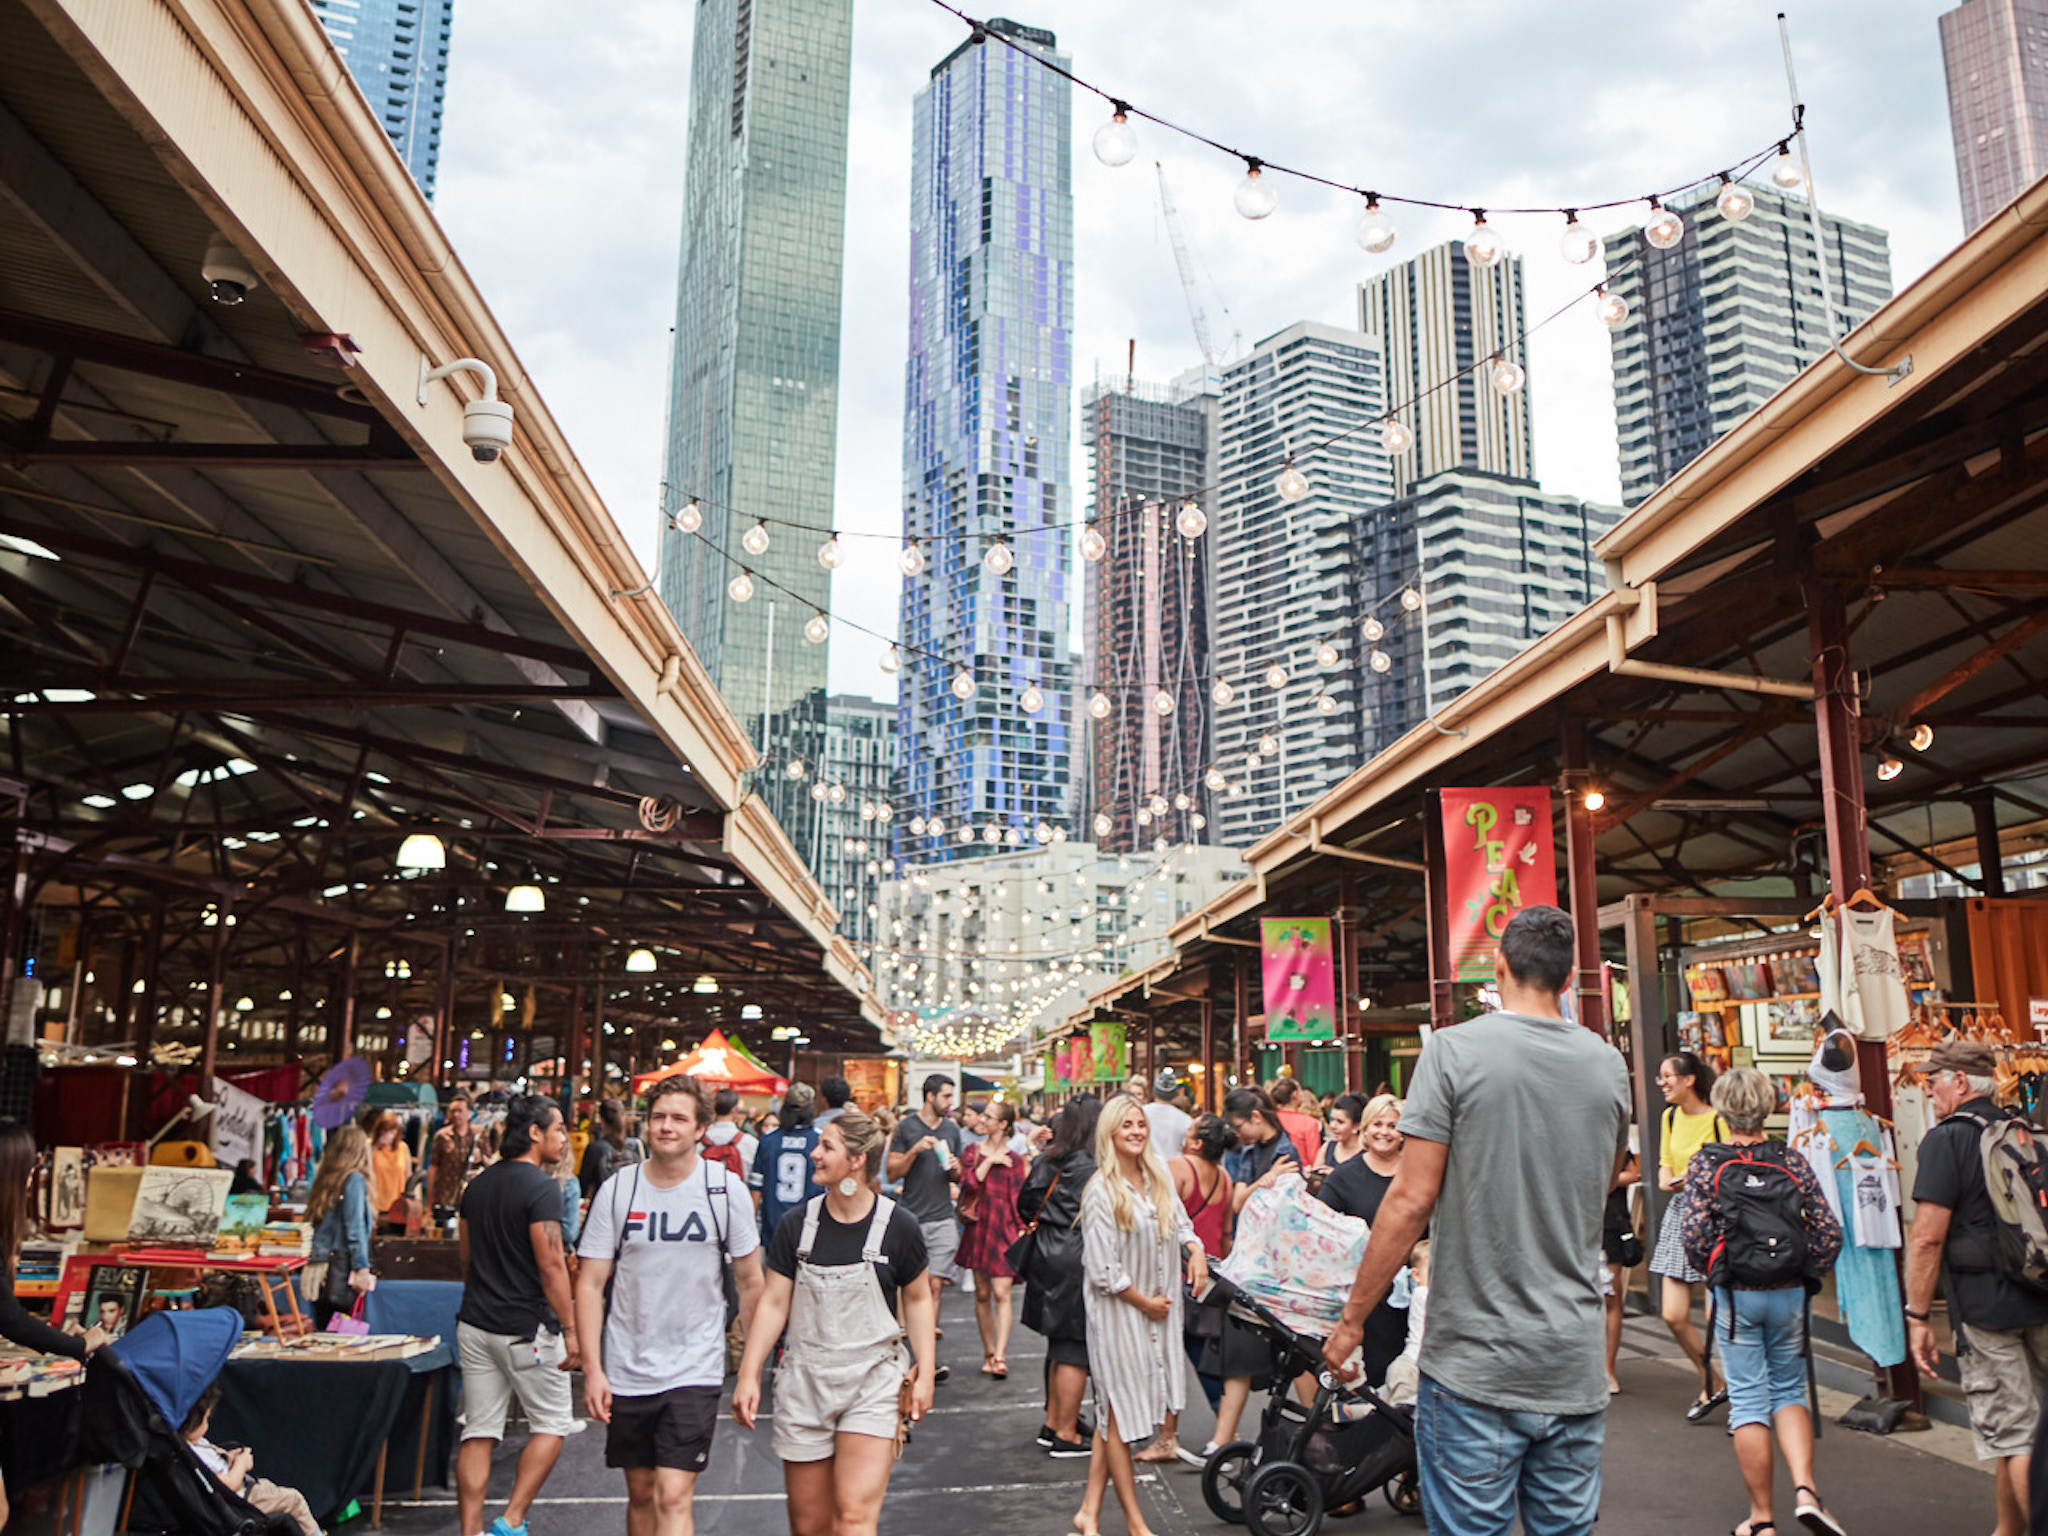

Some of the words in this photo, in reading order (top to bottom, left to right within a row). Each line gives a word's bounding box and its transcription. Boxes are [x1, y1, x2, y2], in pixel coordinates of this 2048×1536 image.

[1098, 1027, 1119, 1077] JOY
[776, 1152, 807, 1203] 9
[624, 1211, 707, 1241] FILA
